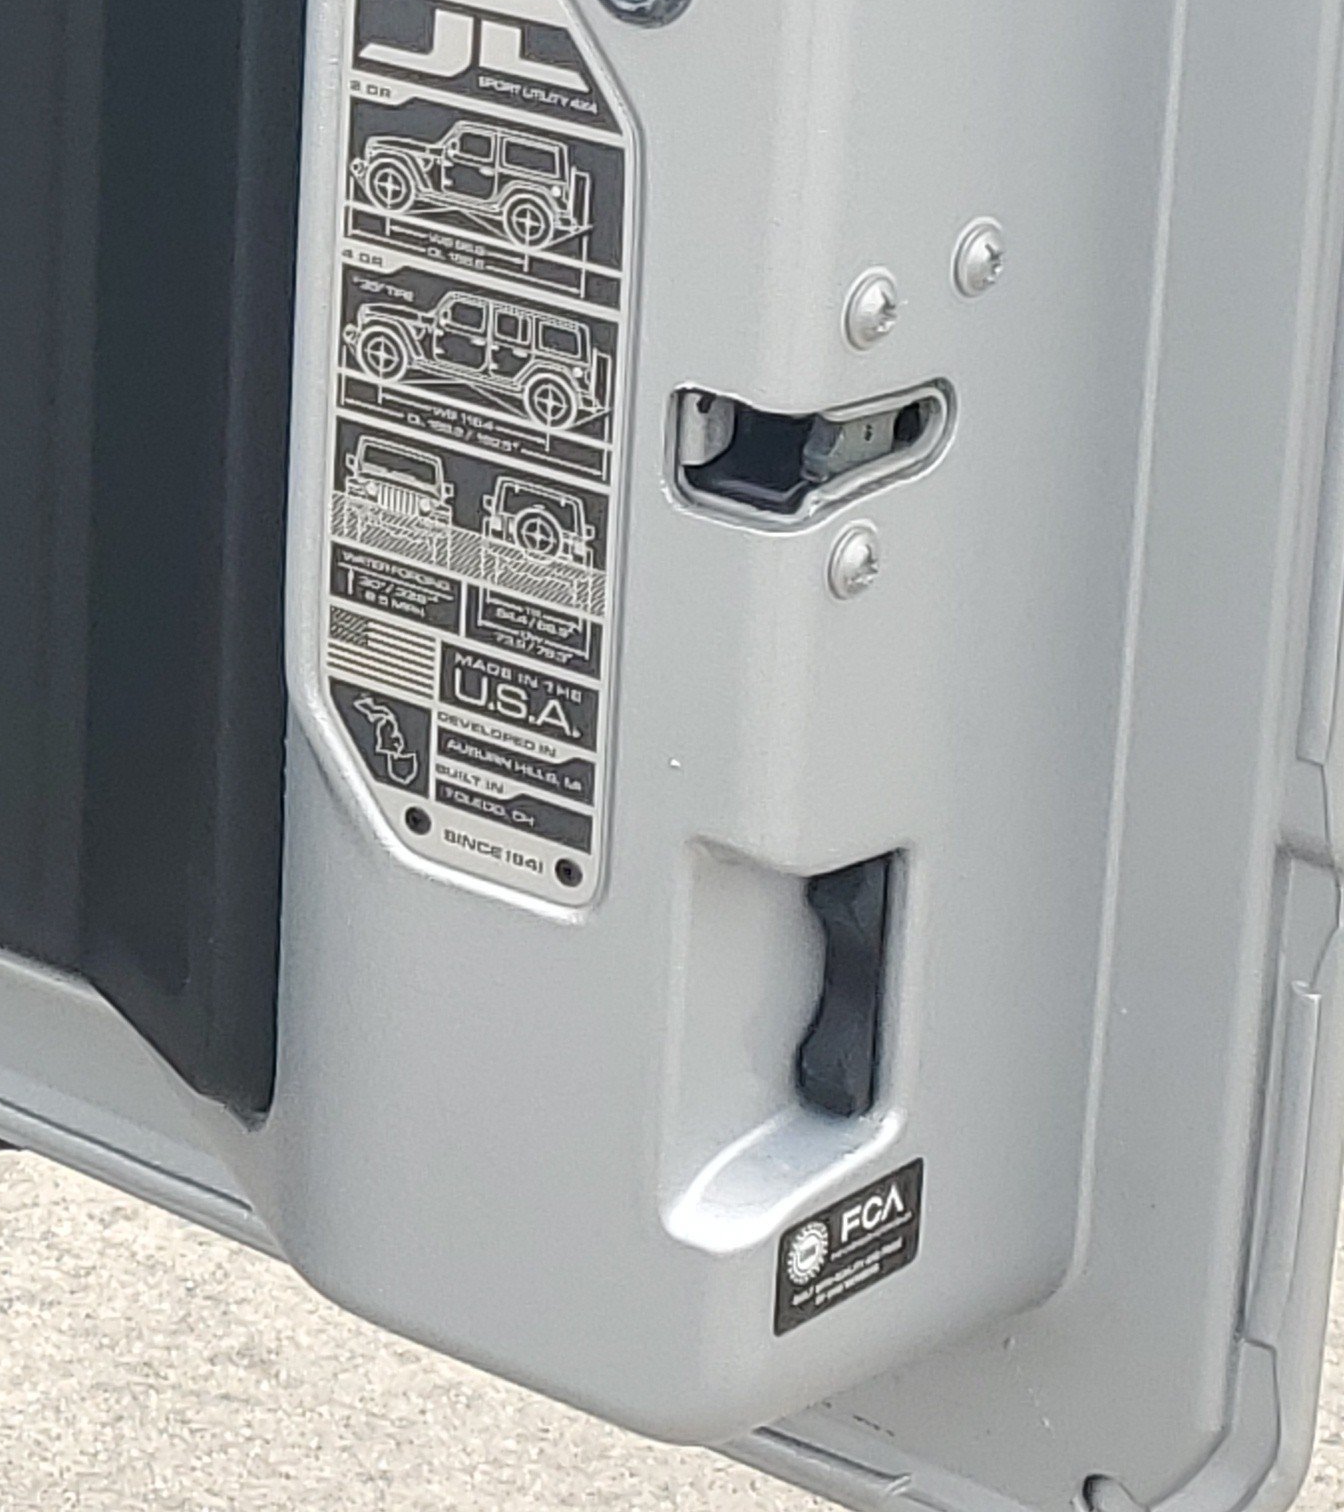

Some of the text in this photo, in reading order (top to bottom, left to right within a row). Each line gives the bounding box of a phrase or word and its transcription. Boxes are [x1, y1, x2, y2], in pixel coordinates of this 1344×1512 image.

[358, 7, 590, 94] JL
[454, 668, 583, 738] U.S.A.
[518, 672, 539, 689] IN
[437, 711, 557, 759] DEVELOPED IN
[436, 762, 505, 795] BUILT IN
[443, 827, 503, 860] SINCE
[841, 1184, 905, 1244] FCA
